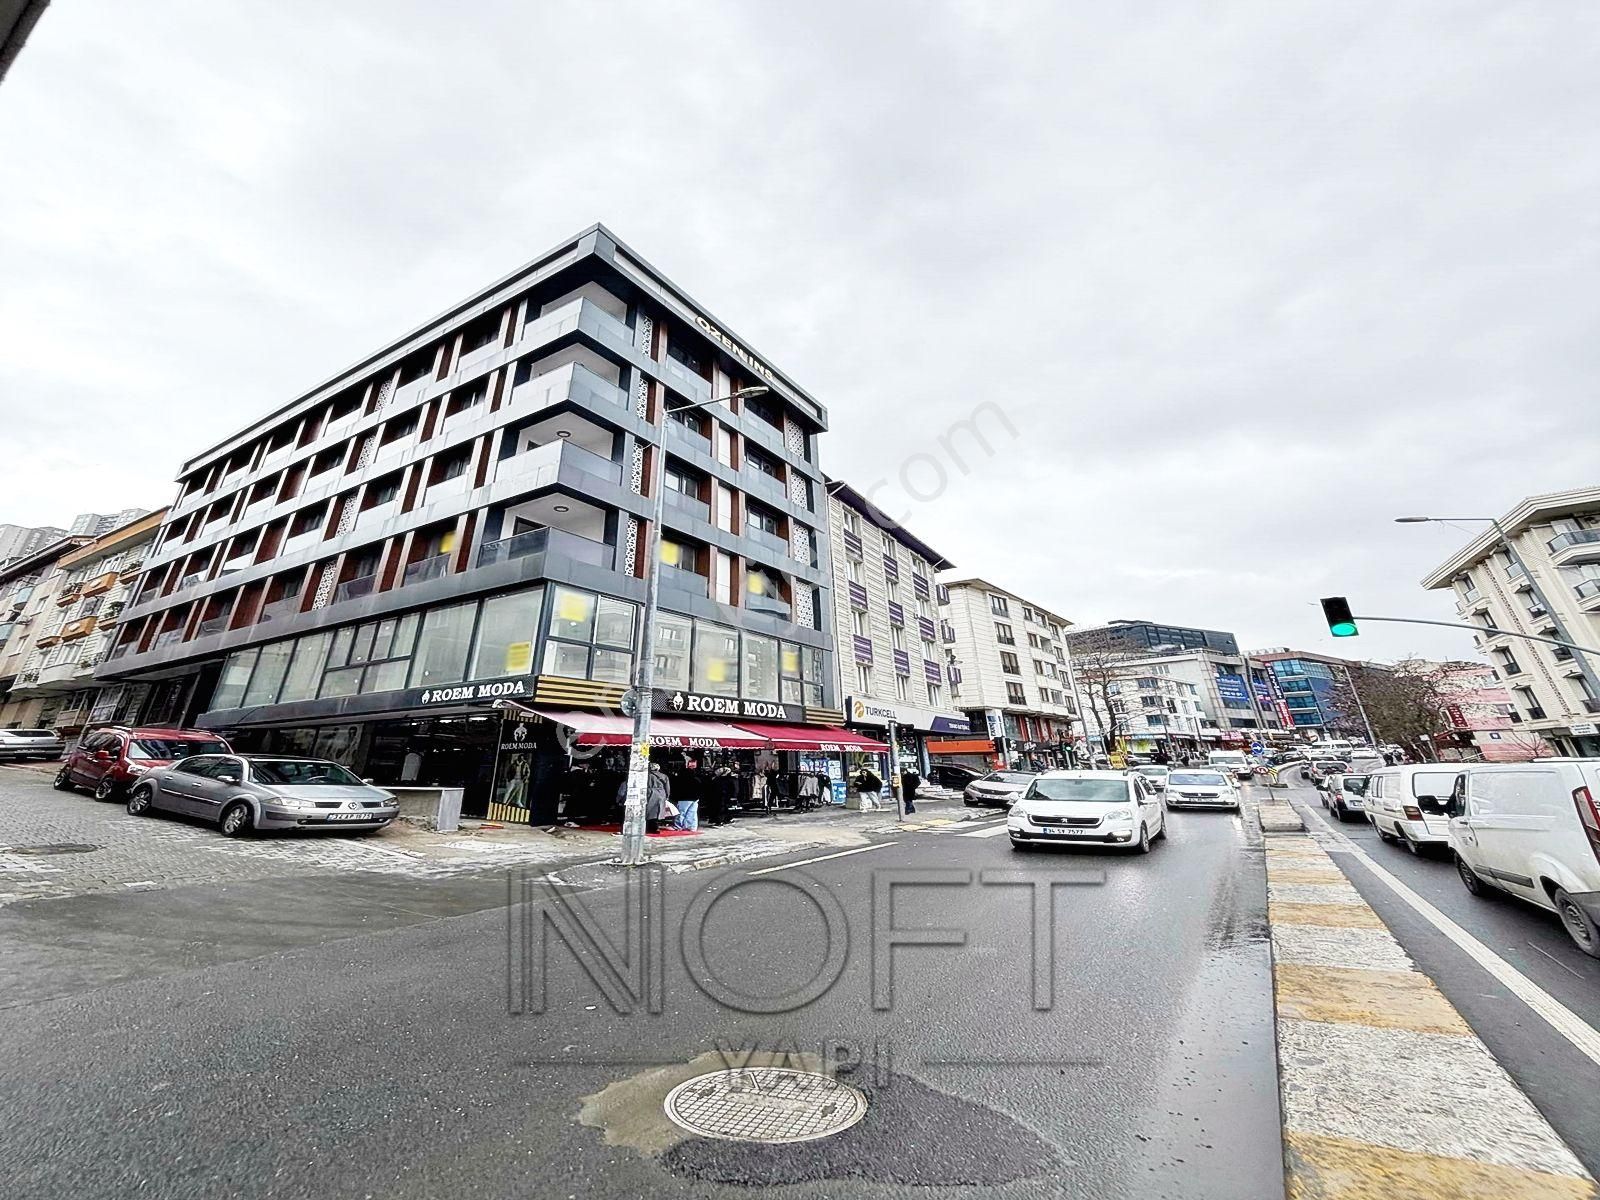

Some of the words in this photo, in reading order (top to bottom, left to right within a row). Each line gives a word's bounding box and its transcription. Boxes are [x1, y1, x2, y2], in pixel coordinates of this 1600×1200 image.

[430, 685, 475, 702] ROEM
[477, 680, 525, 697] MODA
[687, 695, 740, 714] ROEM
[744, 701, 787, 719] MODA
[865, 705, 897, 720] TURKCELL
[500, 742, 518, 750] ROEM
[518, 742, 537, 750] MODA
[648, 736, 682, 747] ROEM
[689, 738, 720, 748] MODA
[820, 743, 841, 752] ROEM
[844, 744, 864, 753] MODA
